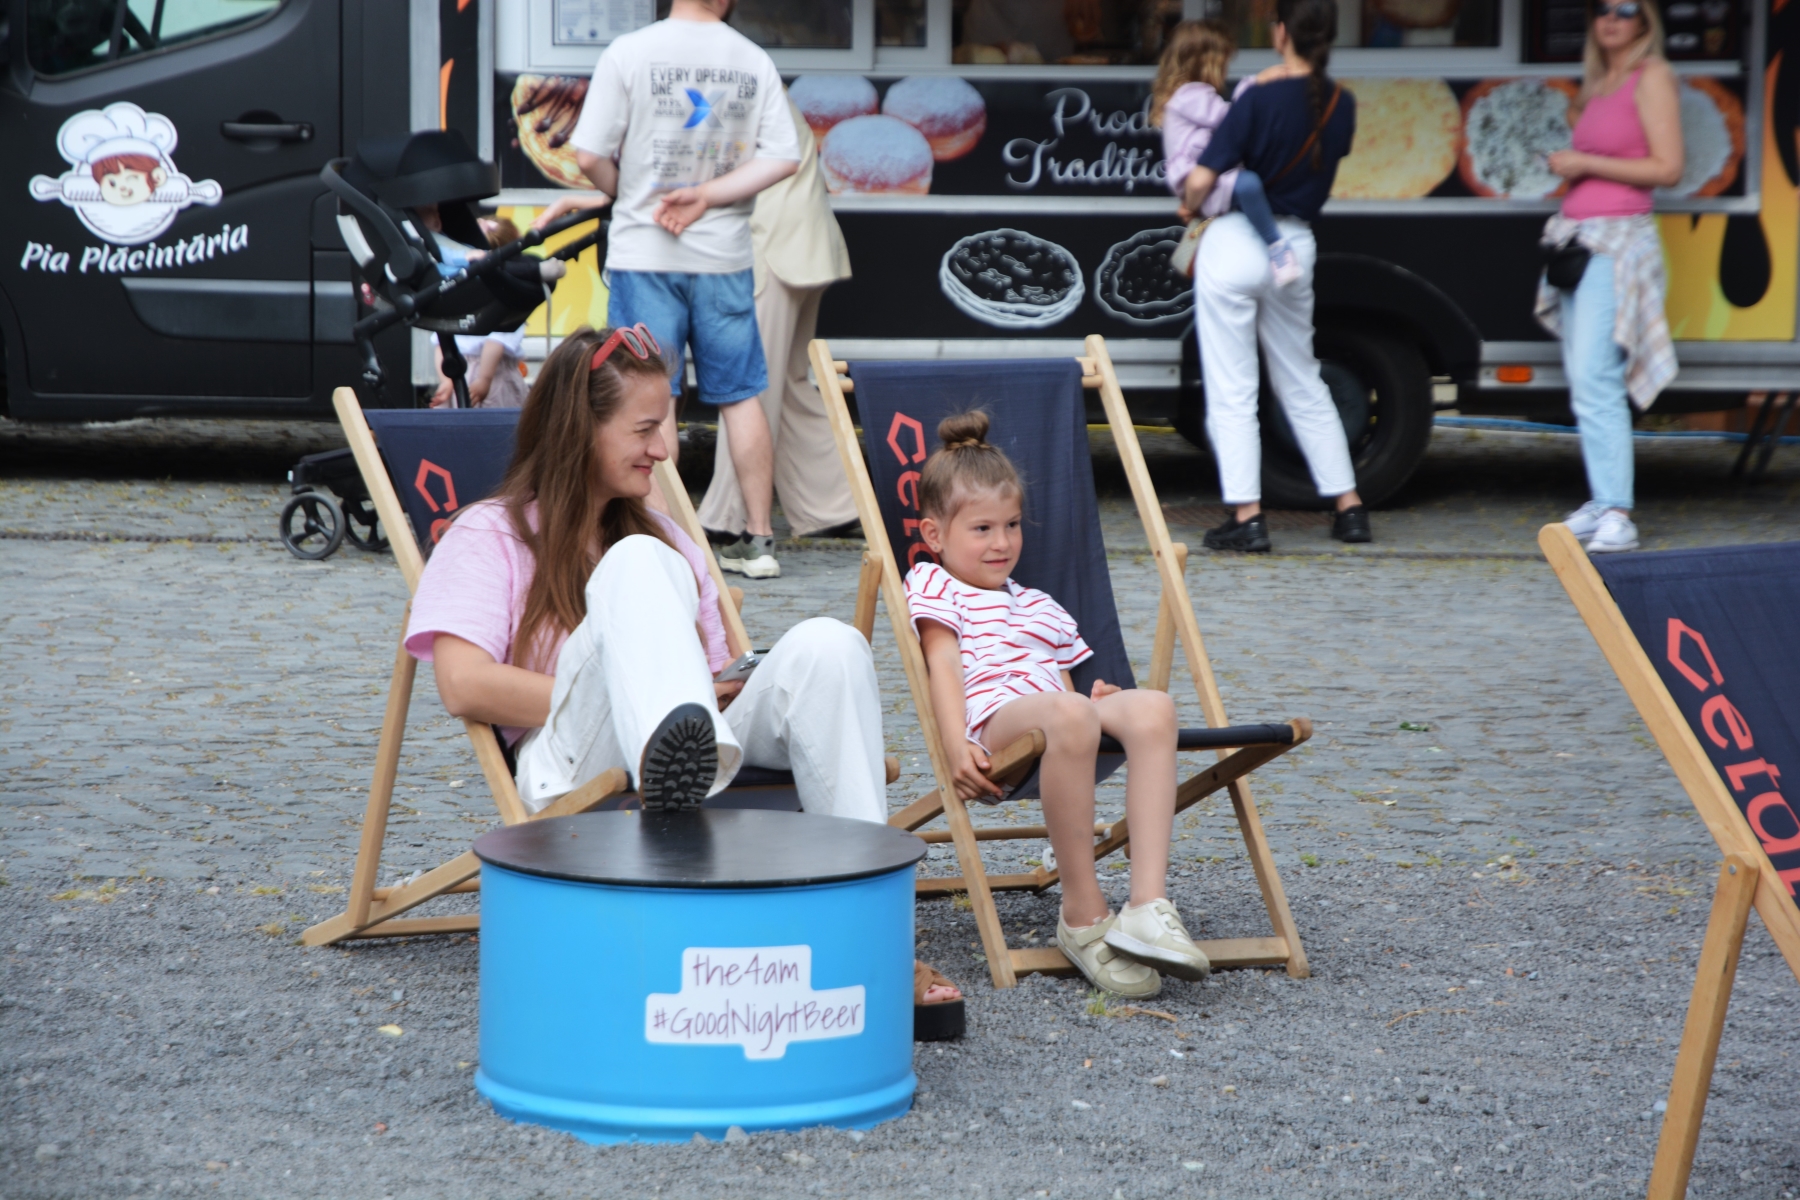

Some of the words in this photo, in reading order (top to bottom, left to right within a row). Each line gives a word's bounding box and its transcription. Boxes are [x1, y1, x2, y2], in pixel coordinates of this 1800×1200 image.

[650, 68, 691, 82] EVERY
[695, 68, 758, 86] OPERATION
[651, 82, 673, 95] ONE
[738, 85, 757, 99] ERP
[1045, 87, 1163, 137] Prod
[1003, 138, 1167, 192] Tradițio
[20, 240, 70, 273] Pia
[79, 223, 249, 273] Plăcintăria
[692, 953, 799, 987] the4am
[653, 998, 862, 1052] #GoodNightBeer
